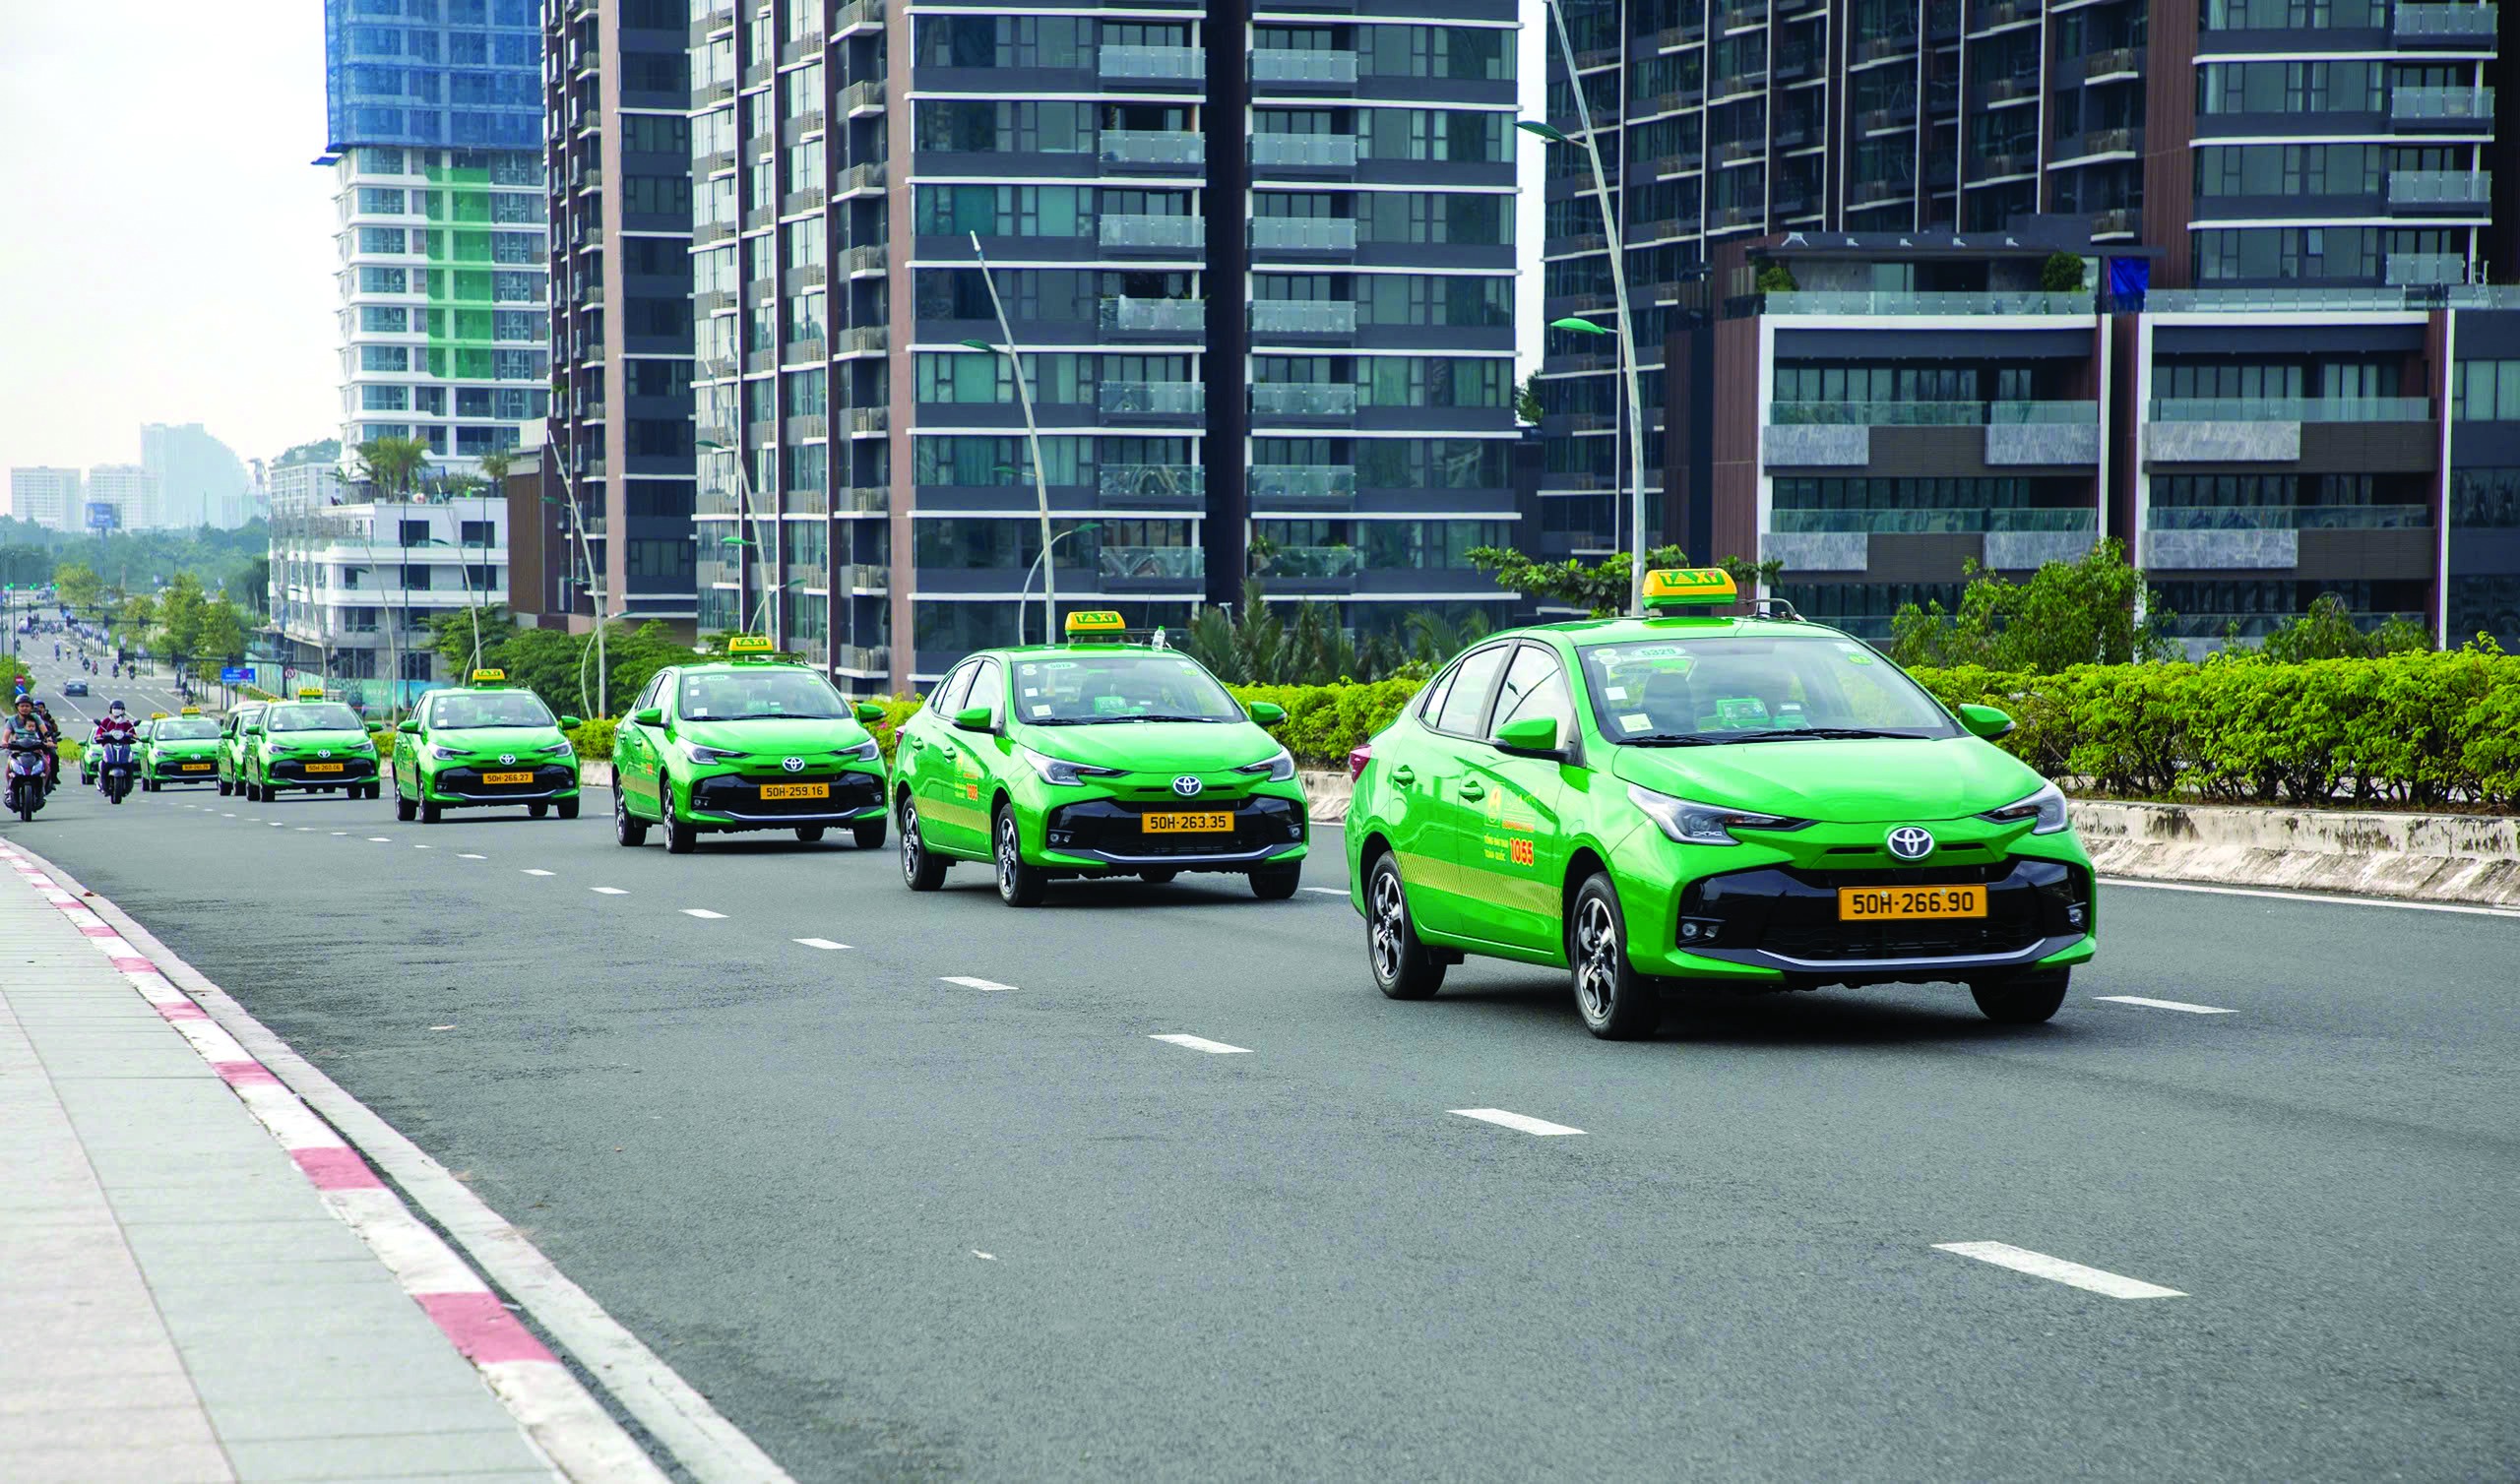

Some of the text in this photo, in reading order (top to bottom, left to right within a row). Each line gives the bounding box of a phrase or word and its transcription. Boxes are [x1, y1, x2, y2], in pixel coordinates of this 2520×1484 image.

[1659, 571, 1719, 585] TAXI
[1075, 613, 1114, 623] TAXI
[766, 785, 824, 797] 50H-259.16
[1150, 815, 1227, 830] 50H-263.35
[1509, 836, 1535, 867] 1055
[1852, 891, 1975, 914] 50H-266.90
